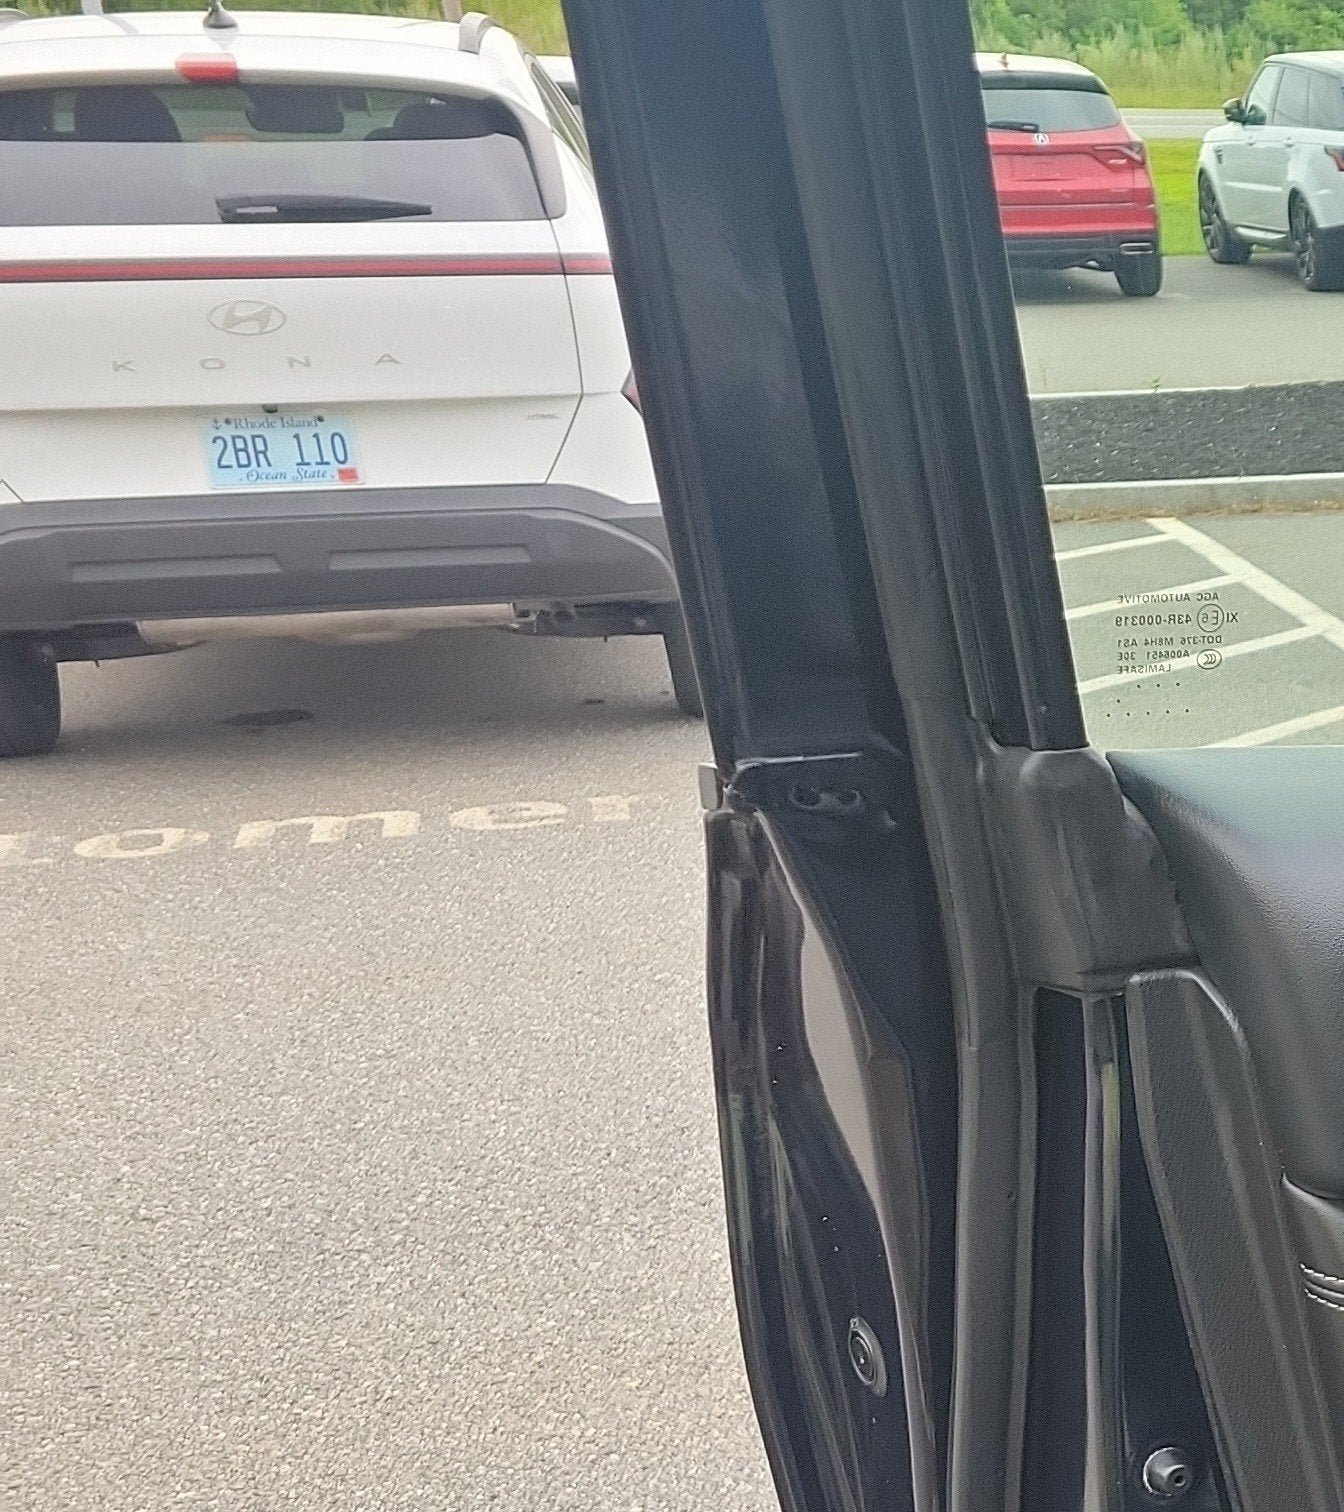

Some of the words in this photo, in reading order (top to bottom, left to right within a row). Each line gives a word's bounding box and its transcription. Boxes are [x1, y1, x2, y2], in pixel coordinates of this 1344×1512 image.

[112, 354, 402, 374] KONA
[234, 417, 277, 430] Rhode
[281, 415, 319, 429] Island
[212, 434, 272, 469] 2BR
[293, 432, 349, 466] 110
[246, 469, 287, 483] Ocean
[291, 466, 328, 482] State
